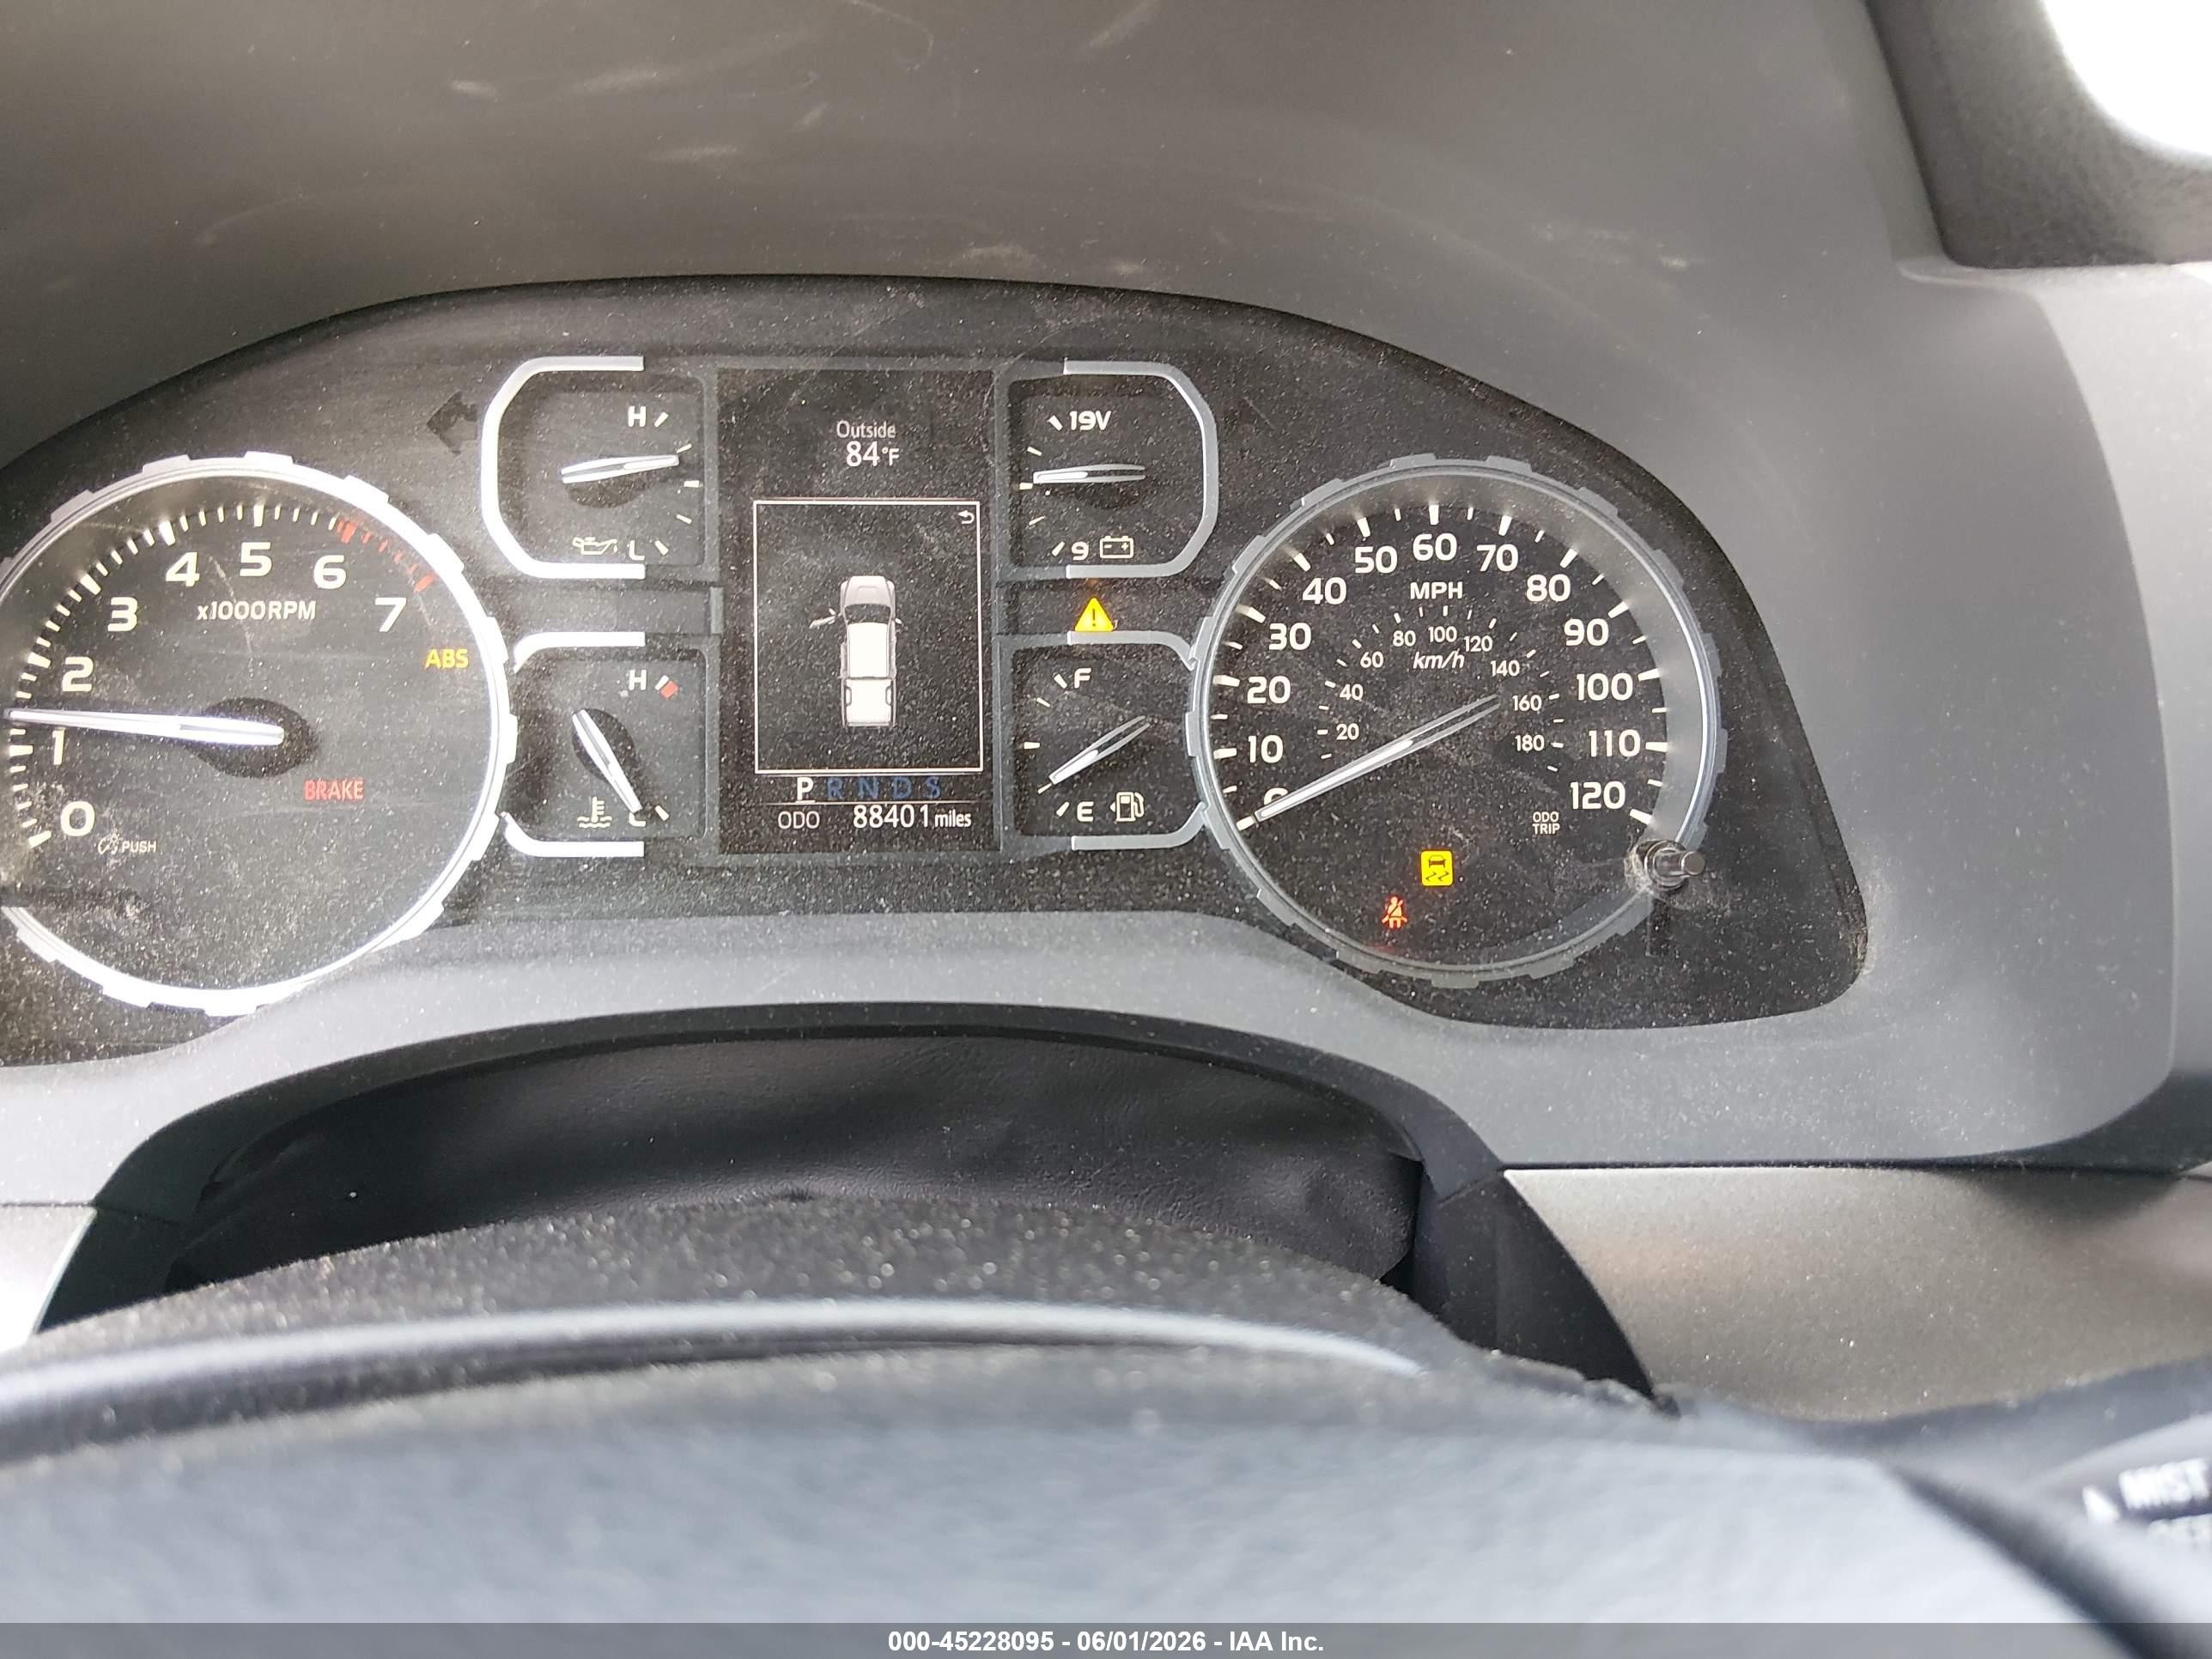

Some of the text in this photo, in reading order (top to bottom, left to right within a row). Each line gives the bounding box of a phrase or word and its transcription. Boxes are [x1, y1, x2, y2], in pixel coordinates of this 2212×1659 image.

[628, 405, 646, 427] H
[1069, 410, 1112, 431] 19V
[836, 420, 896, 439] Outside
[629, 540, 645, 560] L
[1071, 541, 1090, 561] 9
[1413, 533, 1457, 561] 60
[1477, 544, 1518, 572] 70
[166, 552, 199, 586] 4
[240, 542, 271, 576] 5
[1355, 546, 1398, 574] 50
[313, 555, 346, 589] 6
[1302, 577, 1346, 605] 40
[1409, 582, 1463, 599] MPH
[1526, 574, 1571, 602] 80
[107, 597, 137, 632] 3
[374, 597, 406, 632] 7
[1269, 623, 1311, 650] 30
[1392, 630, 1416, 647] 80
[1428, 626, 1457, 643] 100
[1564, 618, 1609, 647] 90
[1464, 635, 1493, 653] 120
[424, 647, 469, 669] ABS
[1360, 651, 1383, 669] 60
[1413, 652, 1465, 669] km/h
[1490, 659, 1520, 677] 140
[62, 657, 93, 692] 2
[629, 669, 647, 690] H
[1074, 668, 1091, 688] F
[1247, 676, 1291, 704] 20
[1340, 684, 1364, 701] 40
[1577, 672, 1633, 701] 100
[1512, 695, 1542, 712] 160
[1336, 723, 1359, 741] 20
[1515, 735, 1545, 751] 180
[1589, 729, 1641, 757] 110
[52, 730, 64, 764] 1
[1248, 735, 1285, 763] 10
[304, 780, 364, 800] BRAKE
[797, 776, 941, 800] P R N D S
[1570, 781, 1626, 810] 120
[61, 802, 94, 836] 0
[778, 805, 972, 830] ODO 88401 miles
[1077, 801, 1094, 822] E
[1532, 811, 1559, 823] ODO
[1532, 823, 1560, 835] TRIP
[121, 840, 156, 853] PUSH
